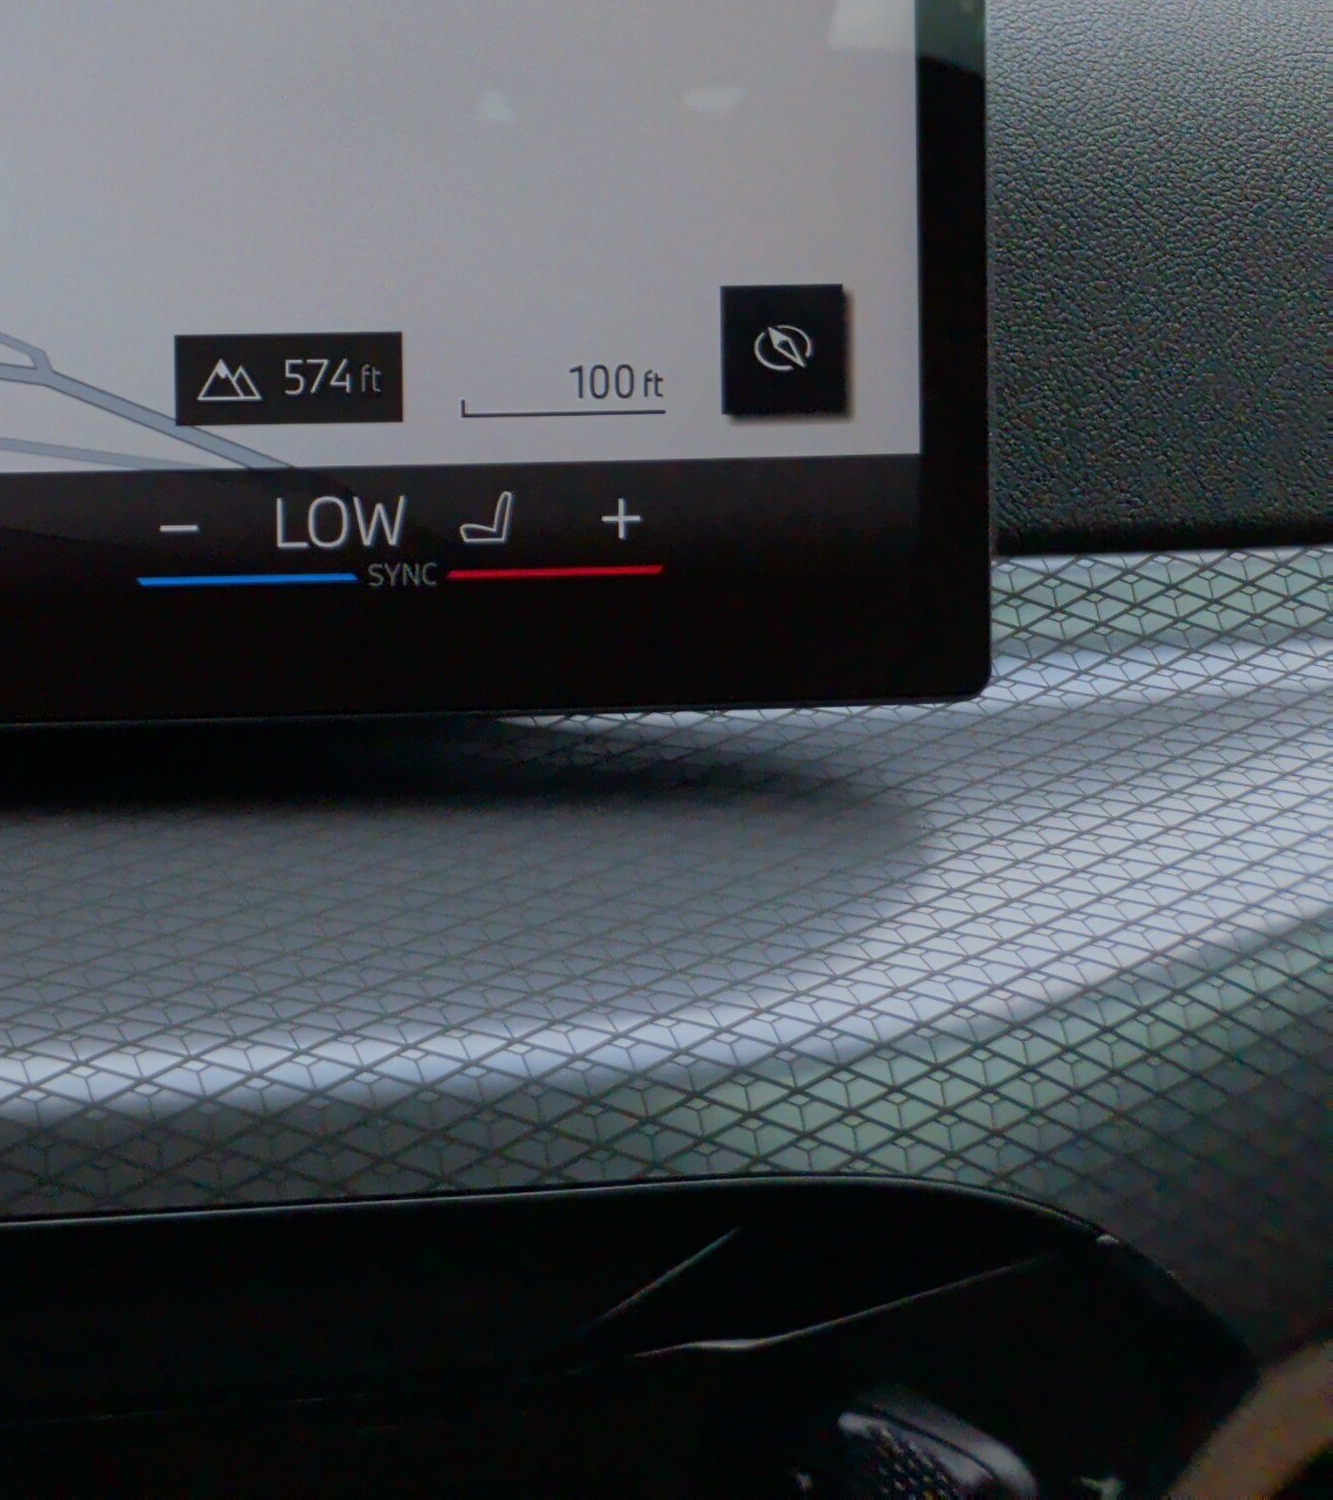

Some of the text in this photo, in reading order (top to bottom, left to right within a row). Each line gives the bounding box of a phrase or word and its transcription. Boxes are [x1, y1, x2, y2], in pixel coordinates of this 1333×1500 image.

[284, 359, 382, 394] 574 ft
[570, 365, 664, 399] 100 ft
[276, 496, 406, 548] LOW
[368, 564, 437, 588] SYNC
